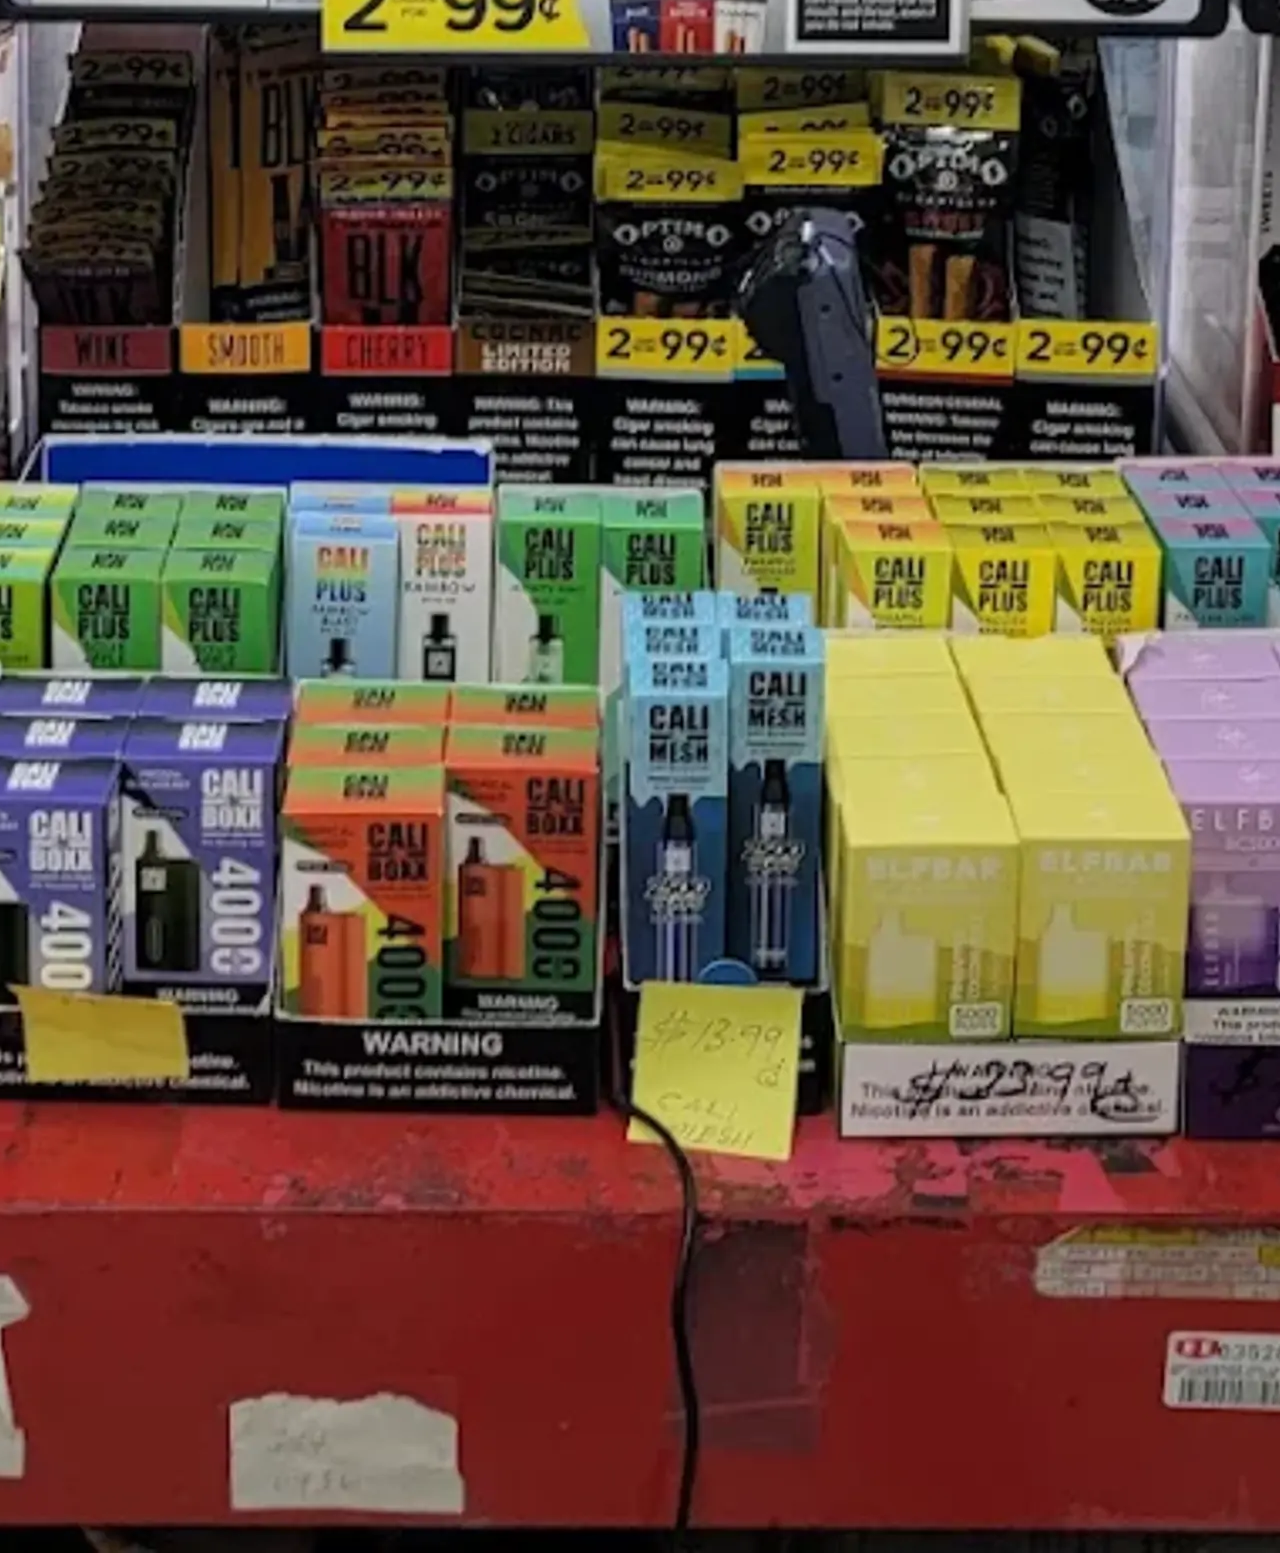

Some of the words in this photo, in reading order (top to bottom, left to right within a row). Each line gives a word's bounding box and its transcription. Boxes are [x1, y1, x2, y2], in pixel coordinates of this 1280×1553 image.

[905, 90, 921, 114] 2
[945, 88, 994, 117] 99¢
[769, 151, 786, 172] 2
[809, 149, 859, 173] 99¢
[347, 232, 427, 307] BLK
[471, 323, 581, 342] COGNAC
[606, 328, 633, 362] 2
[660, 327, 728, 364] 99¢
[887, 328, 912, 359] 2
[940, 328, 1007, 362] 99¢
[75, 333, 131, 363] WINE
[208, 334, 285, 365] SMOOTH
[347, 333, 429, 365] CHERRY
[482, 345, 571, 358] LIMITED
[1026, 331, 1054, 363] 2
[1081, 331, 1148, 364] 99¢
[482, 358, 570, 372] EDITION
[626, 534, 676, 560] CALI
[626, 563, 676, 586] PLUS
[979, 560, 1030, 585] CALI
[188, 588, 239, 614] CALI
[979, 588, 1028, 612] PLUS
[189, 619, 239, 642] PLUS
[648, 705, 710, 732] CALI
[649, 738, 709, 763] MESH
[201, 768, 263, 798] CALI
[526, 777, 586, 805] CALI
[202, 805, 263, 829] BOXX
[526, 811, 586, 836] BOXX
